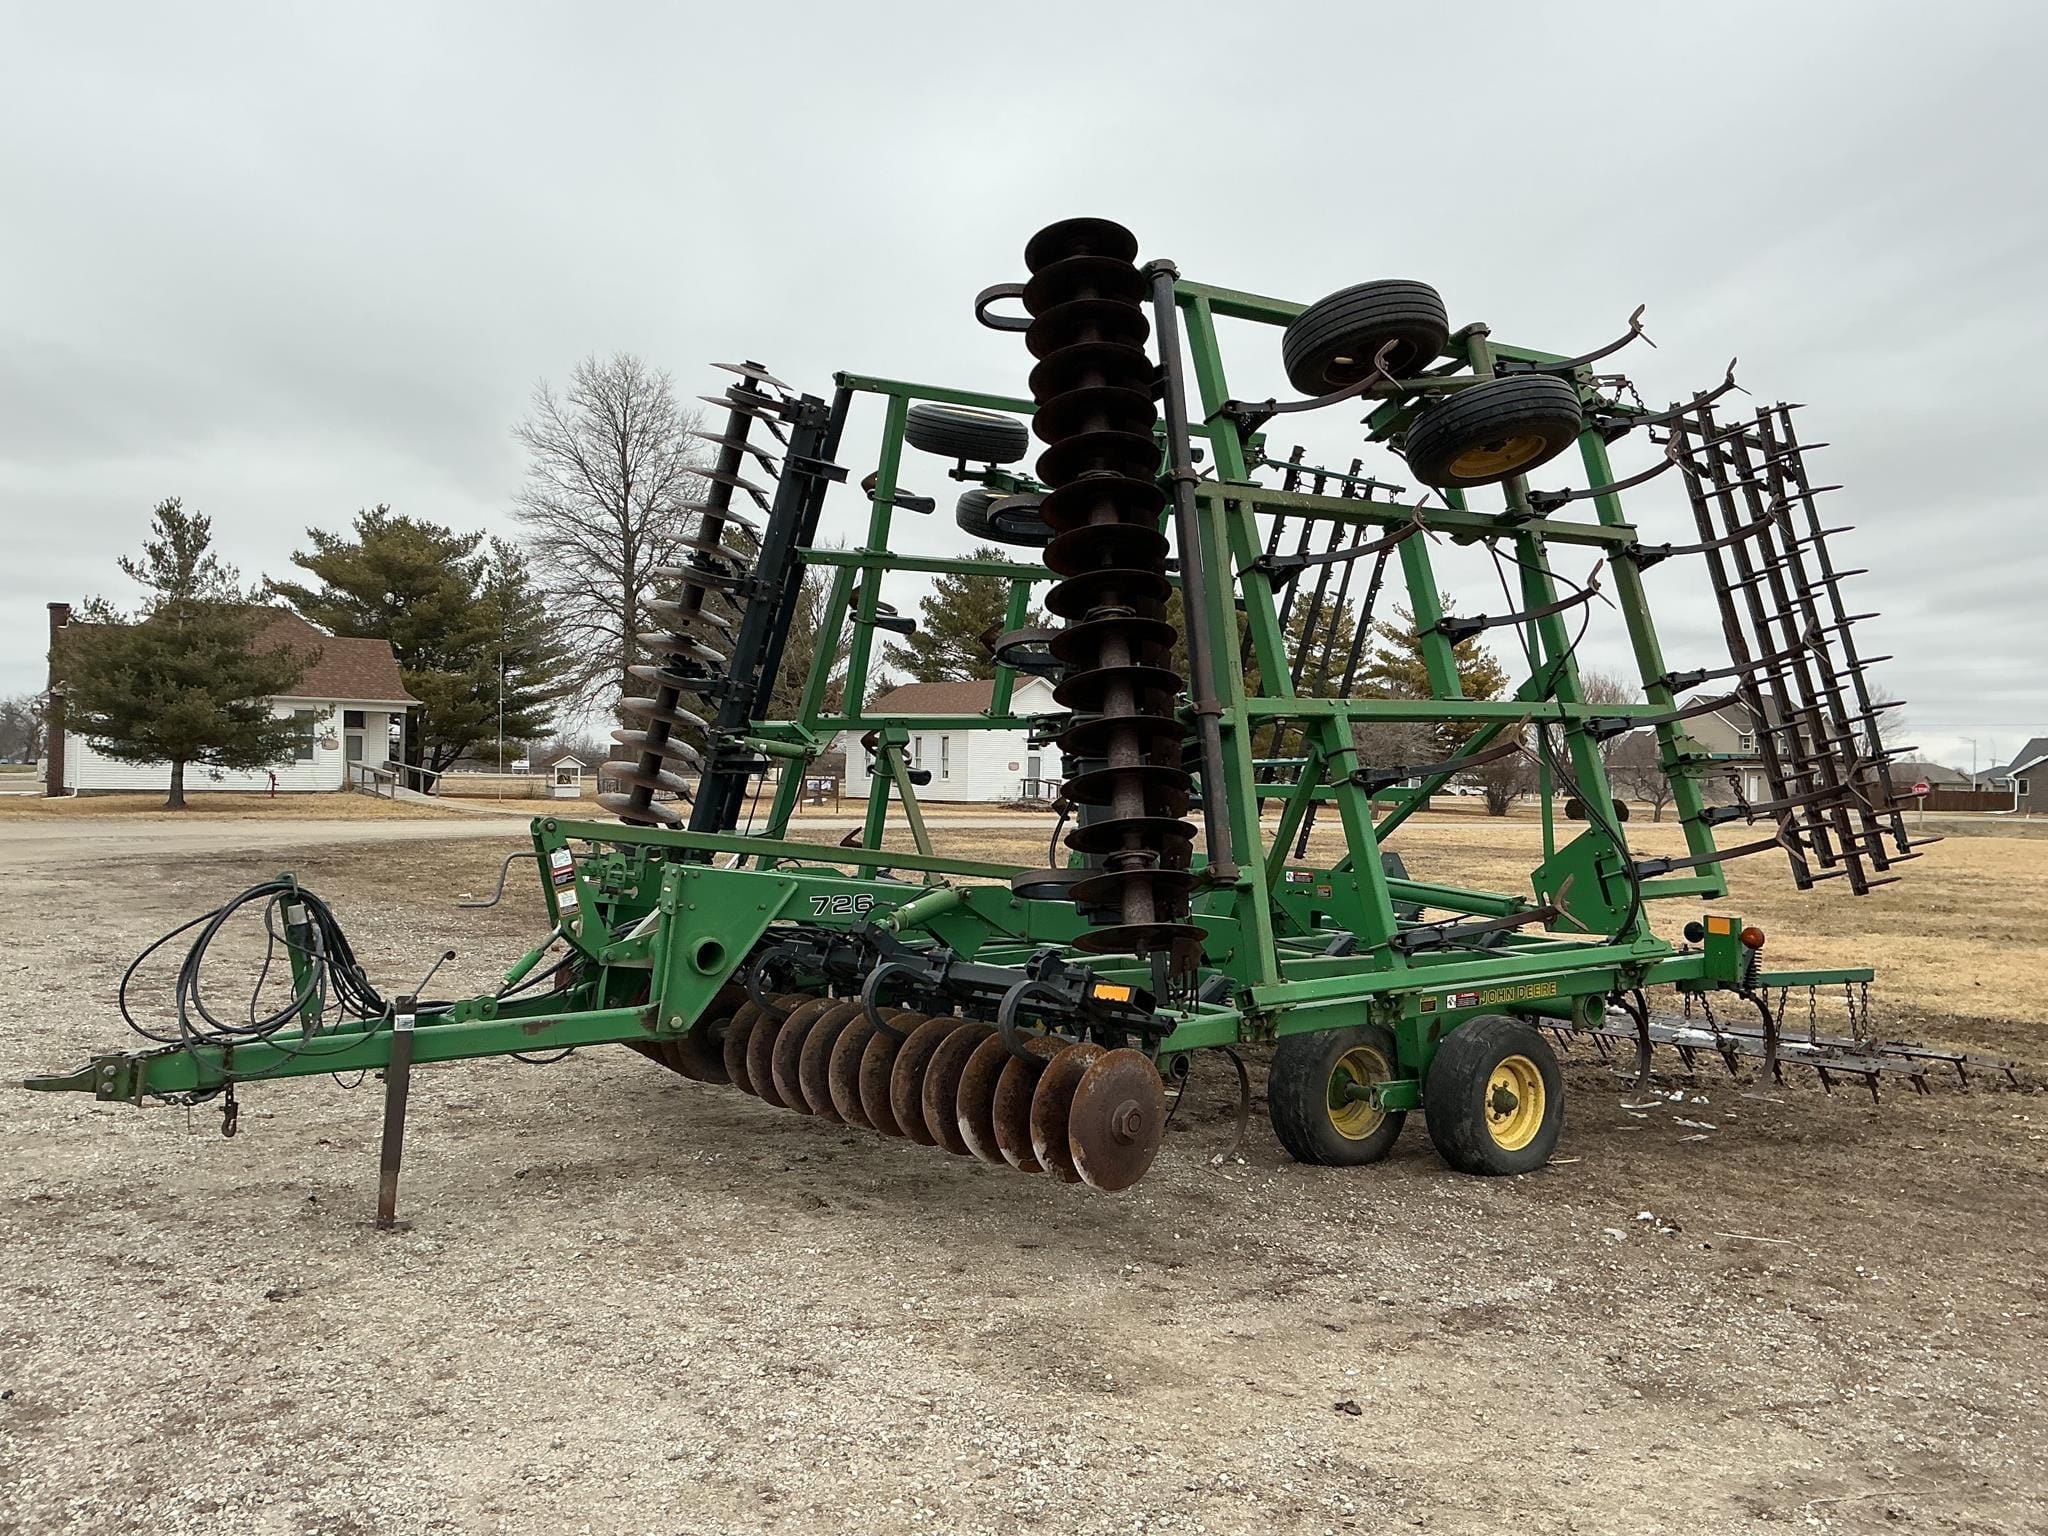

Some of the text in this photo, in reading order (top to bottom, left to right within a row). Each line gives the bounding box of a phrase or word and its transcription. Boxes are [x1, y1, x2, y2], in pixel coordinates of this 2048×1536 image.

[809, 893, 875, 916] 726
[1480, 987, 1515, 1005] JOHN
[1517, 981, 1557, 999] DEERE
